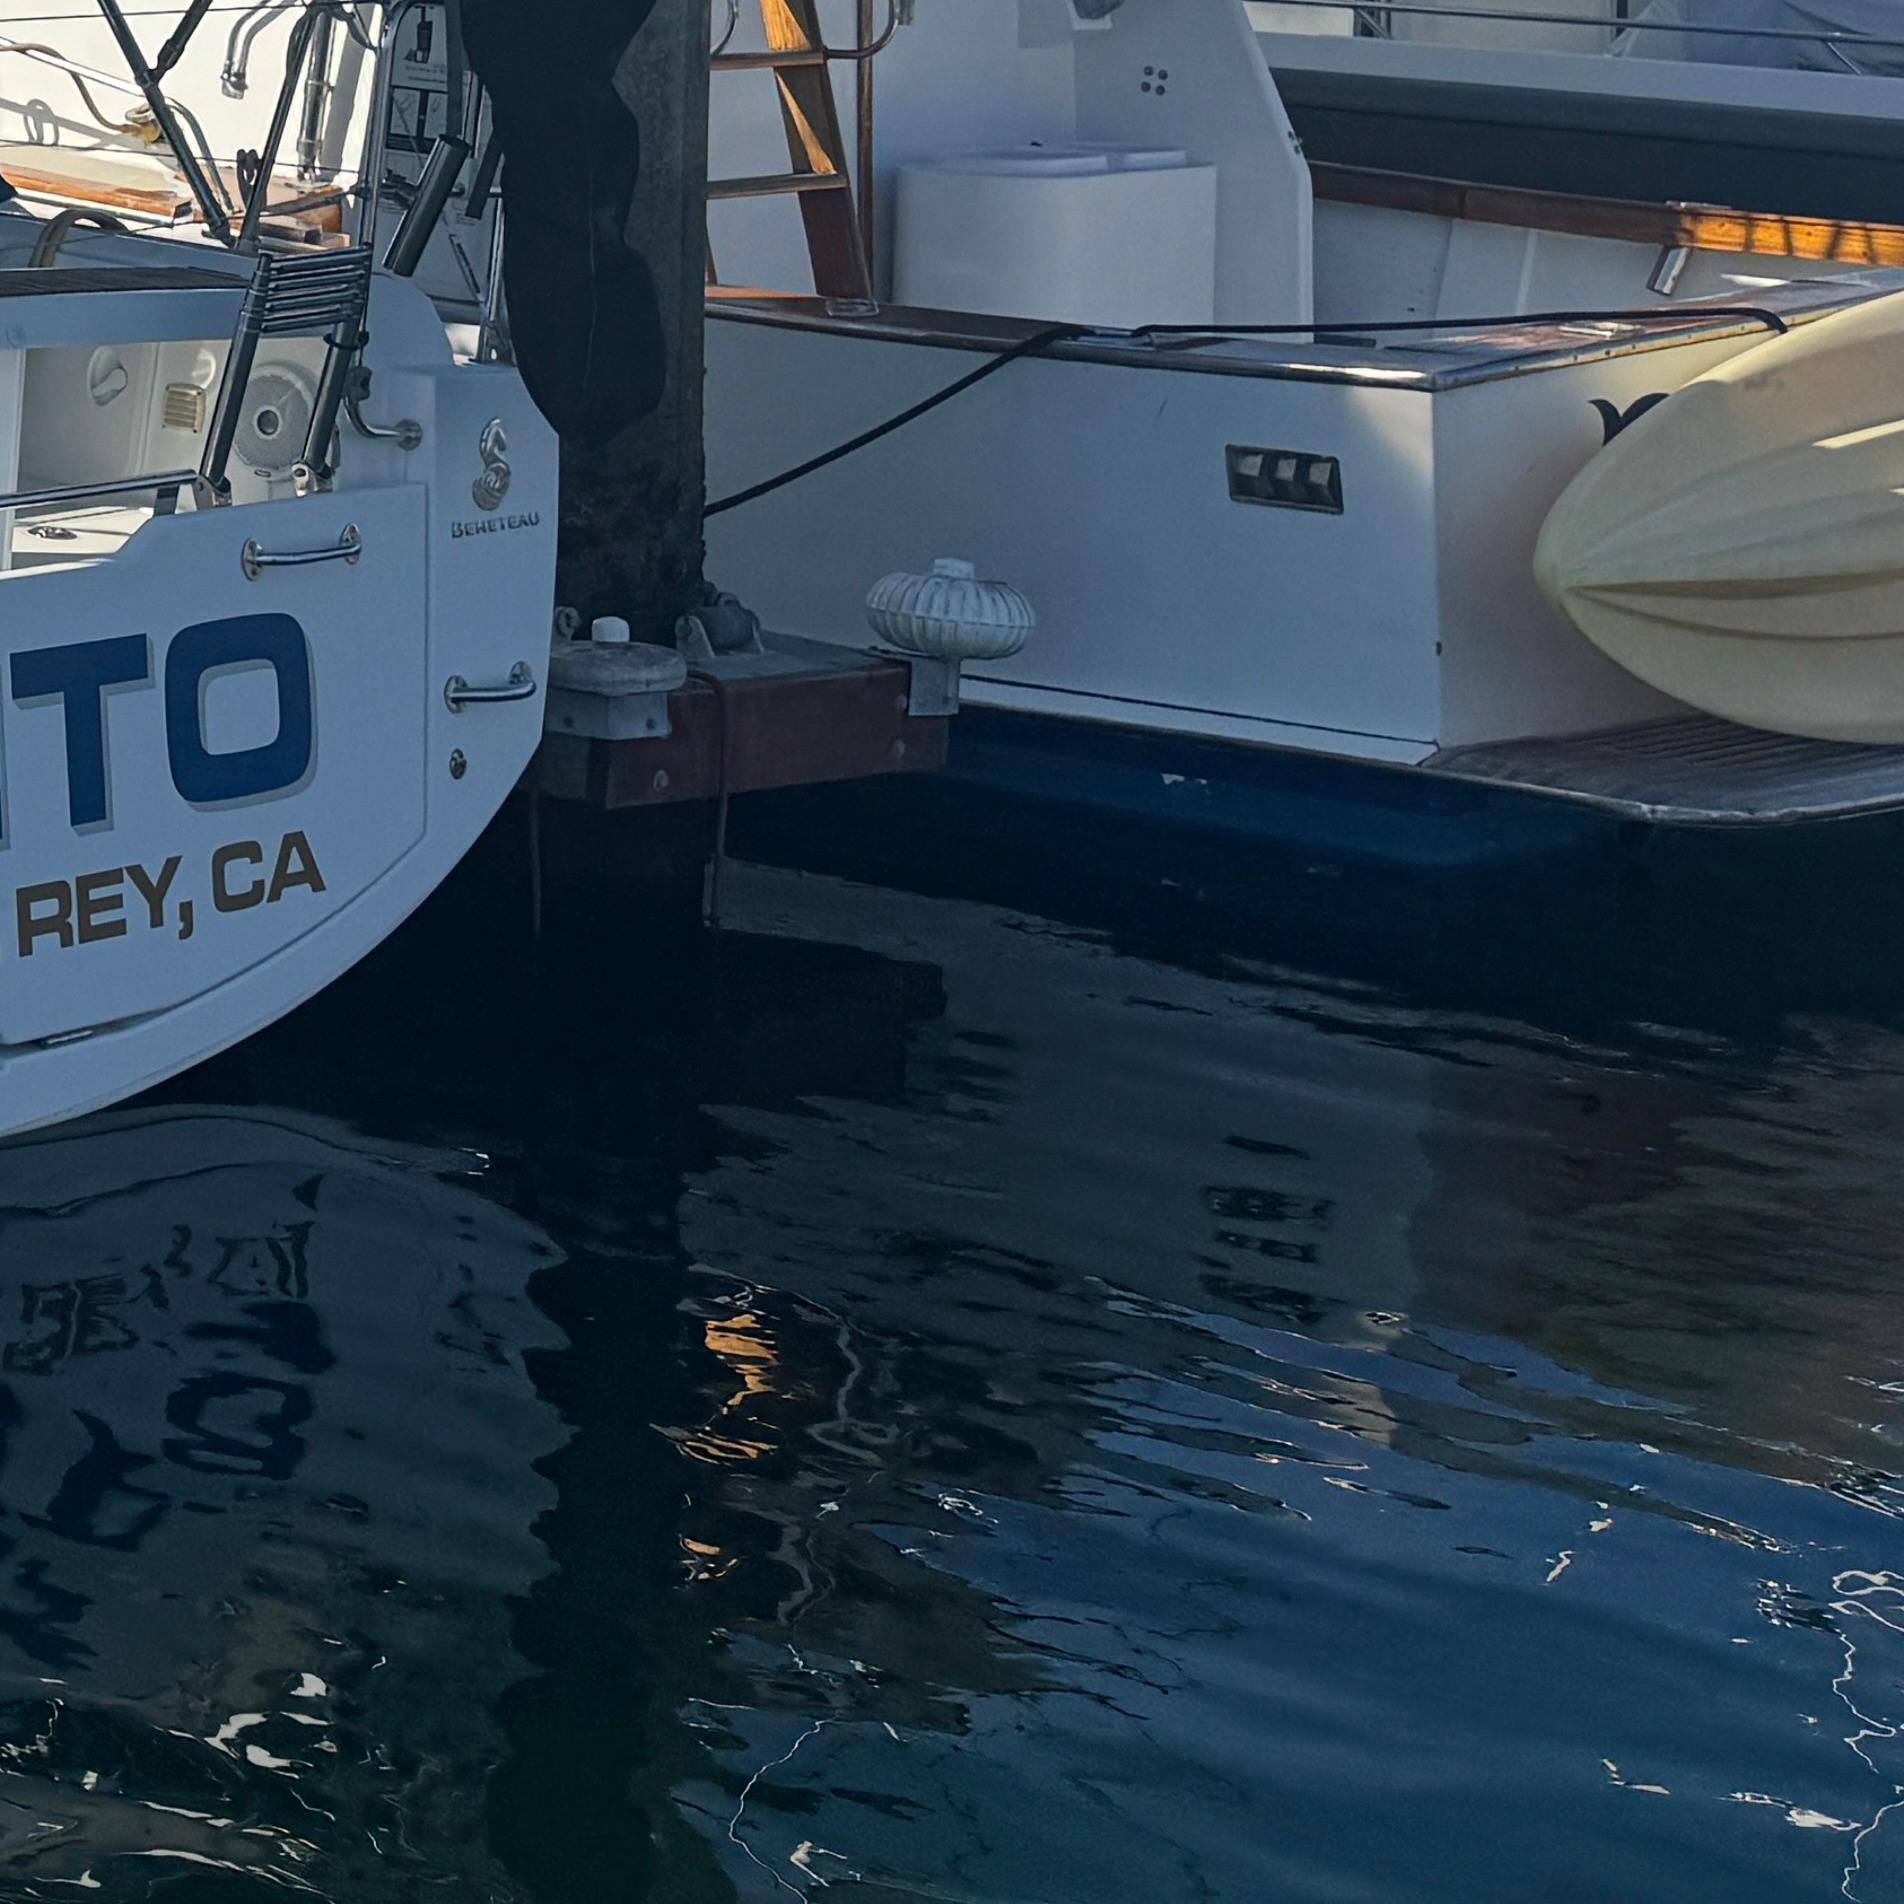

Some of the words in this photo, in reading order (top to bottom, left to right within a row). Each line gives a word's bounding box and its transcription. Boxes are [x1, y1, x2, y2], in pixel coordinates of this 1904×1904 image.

[451, 512, 541, 539] BENETEAU
[16, 853, 195, 959] REY,
[209, 829, 327, 914] CA
